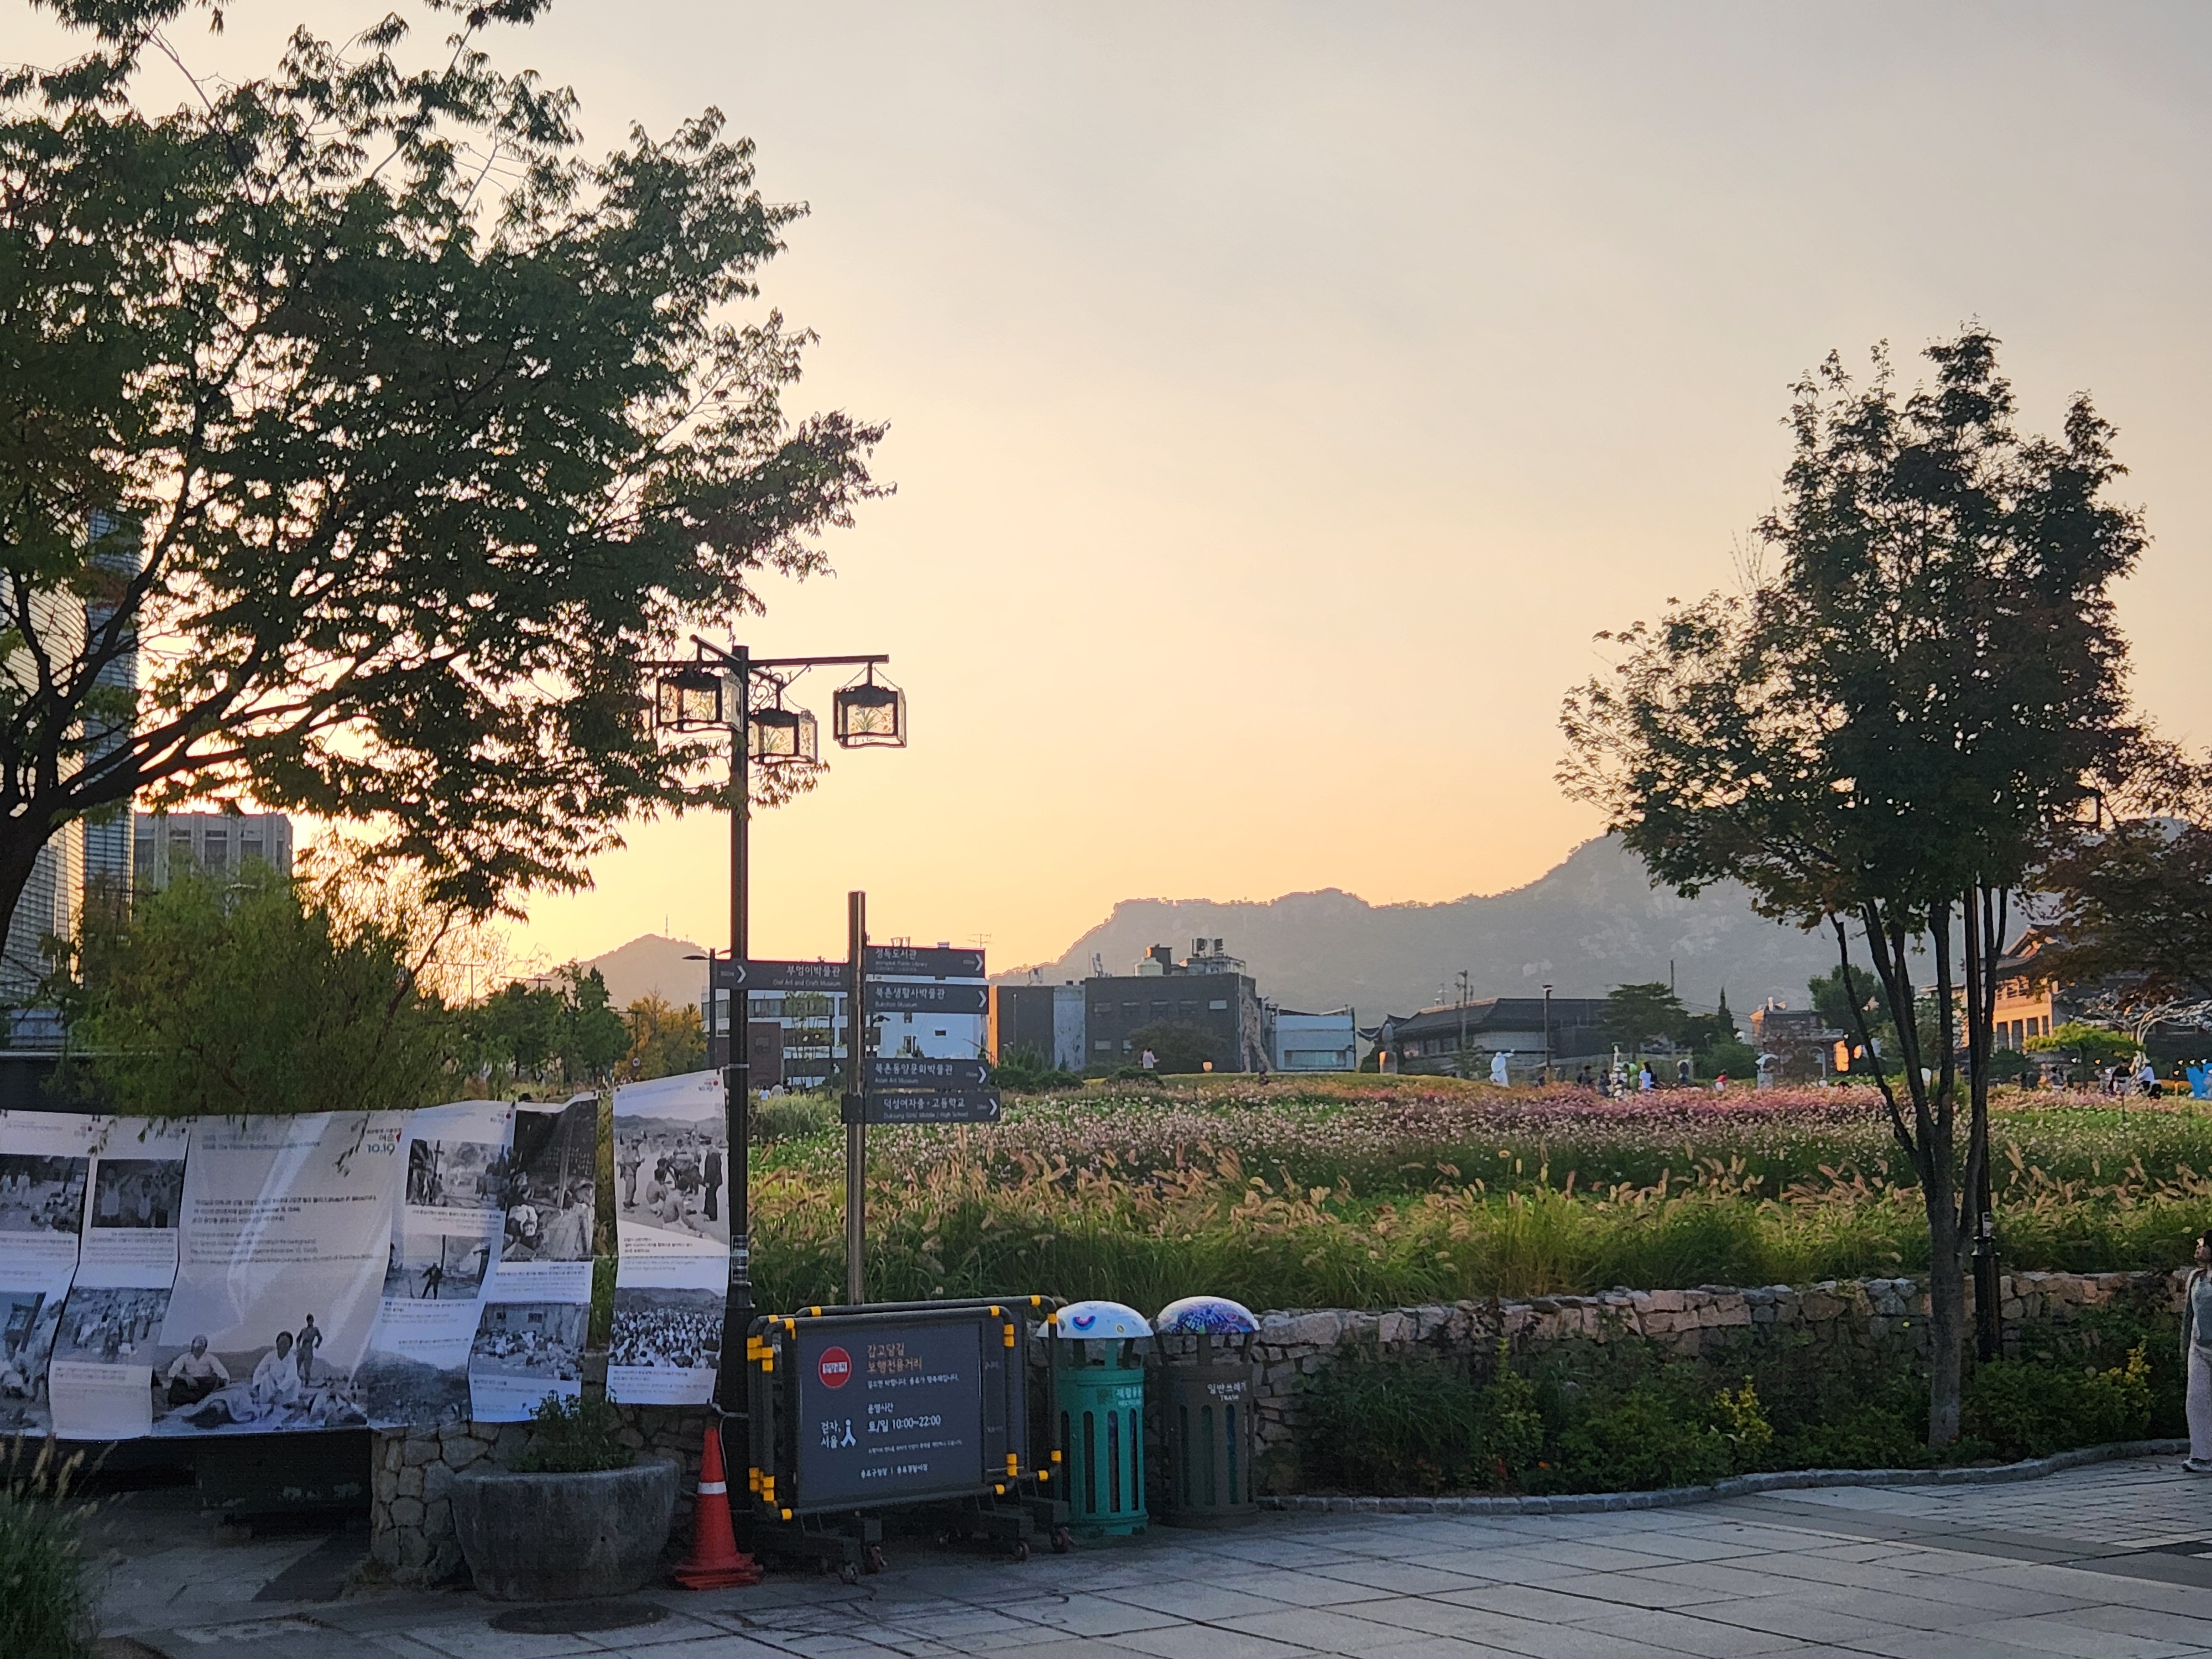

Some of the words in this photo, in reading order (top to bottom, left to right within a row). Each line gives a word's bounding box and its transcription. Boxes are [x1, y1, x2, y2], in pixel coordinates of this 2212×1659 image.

[875, 948, 917, 960] 정독도서관
[786, 965, 841, 977] 부엉이박물관
[875, 987, 945, 999] 북촌생활사박물관
[367, 1144, 395, 1156] 10.19
[867, 1357, 923, 1375] 보행전용거리
[821, 1420, 841, 1434] 걷자,
[868, 1419, 889, 1433] 토/일
[892, 1415, 942, 1430] 10:00~22:00
